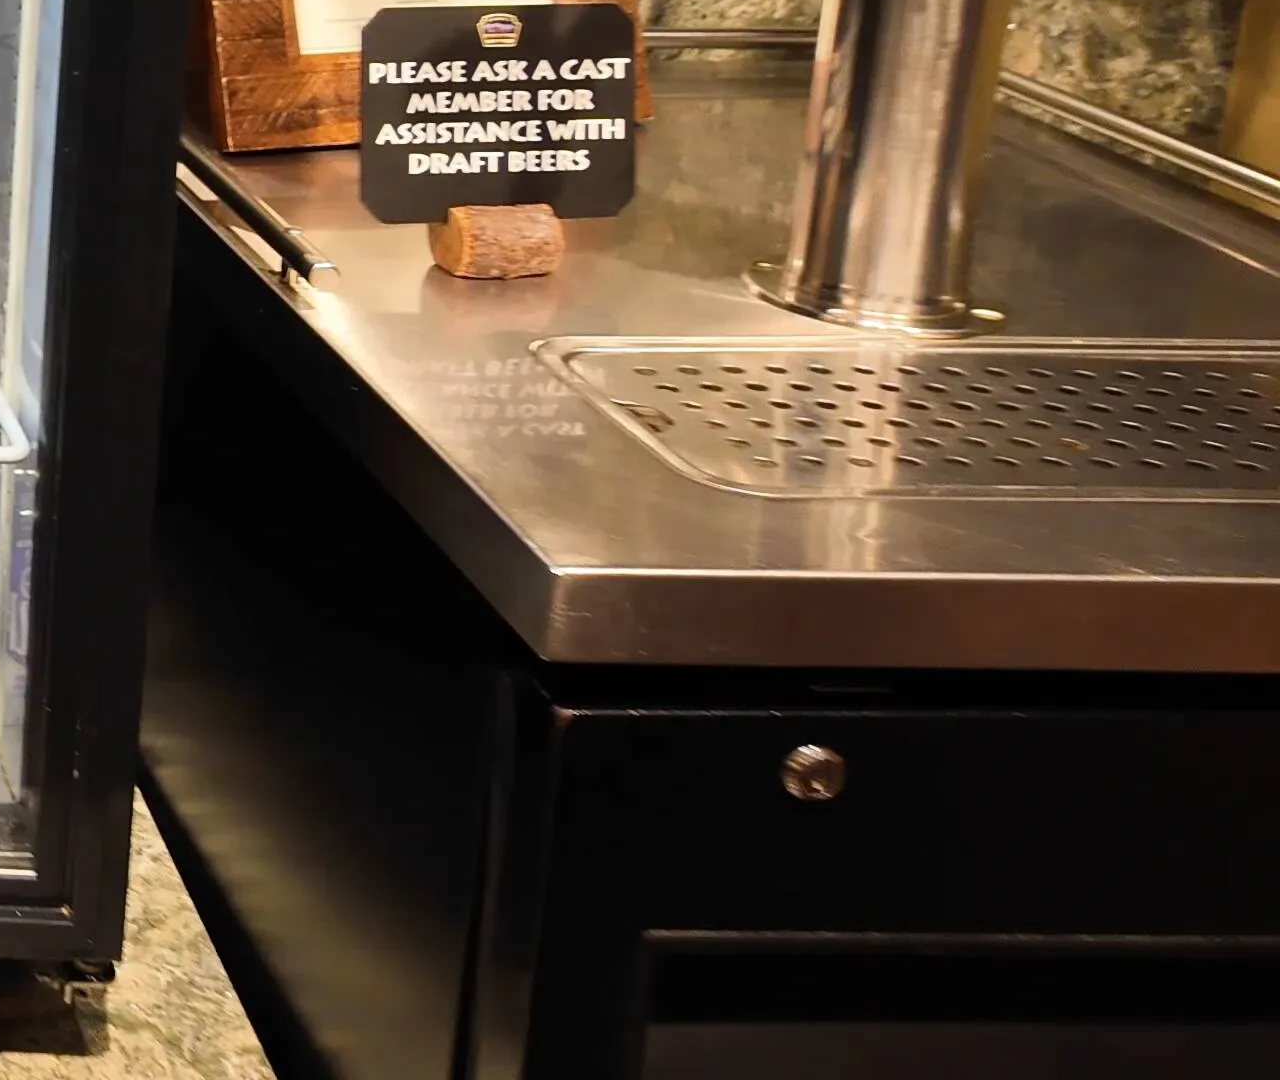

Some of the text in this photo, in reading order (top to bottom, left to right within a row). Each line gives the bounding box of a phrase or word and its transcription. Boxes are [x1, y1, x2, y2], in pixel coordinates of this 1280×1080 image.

[368, 57, 631, 84] PLEASE ASK A CAST
[406, 88, 595, 114] MEMBER FOR
[375, 118, 626, 145] ASSISTANCE WITH
[408, 149, 591, 175] DRAFT BEERS
